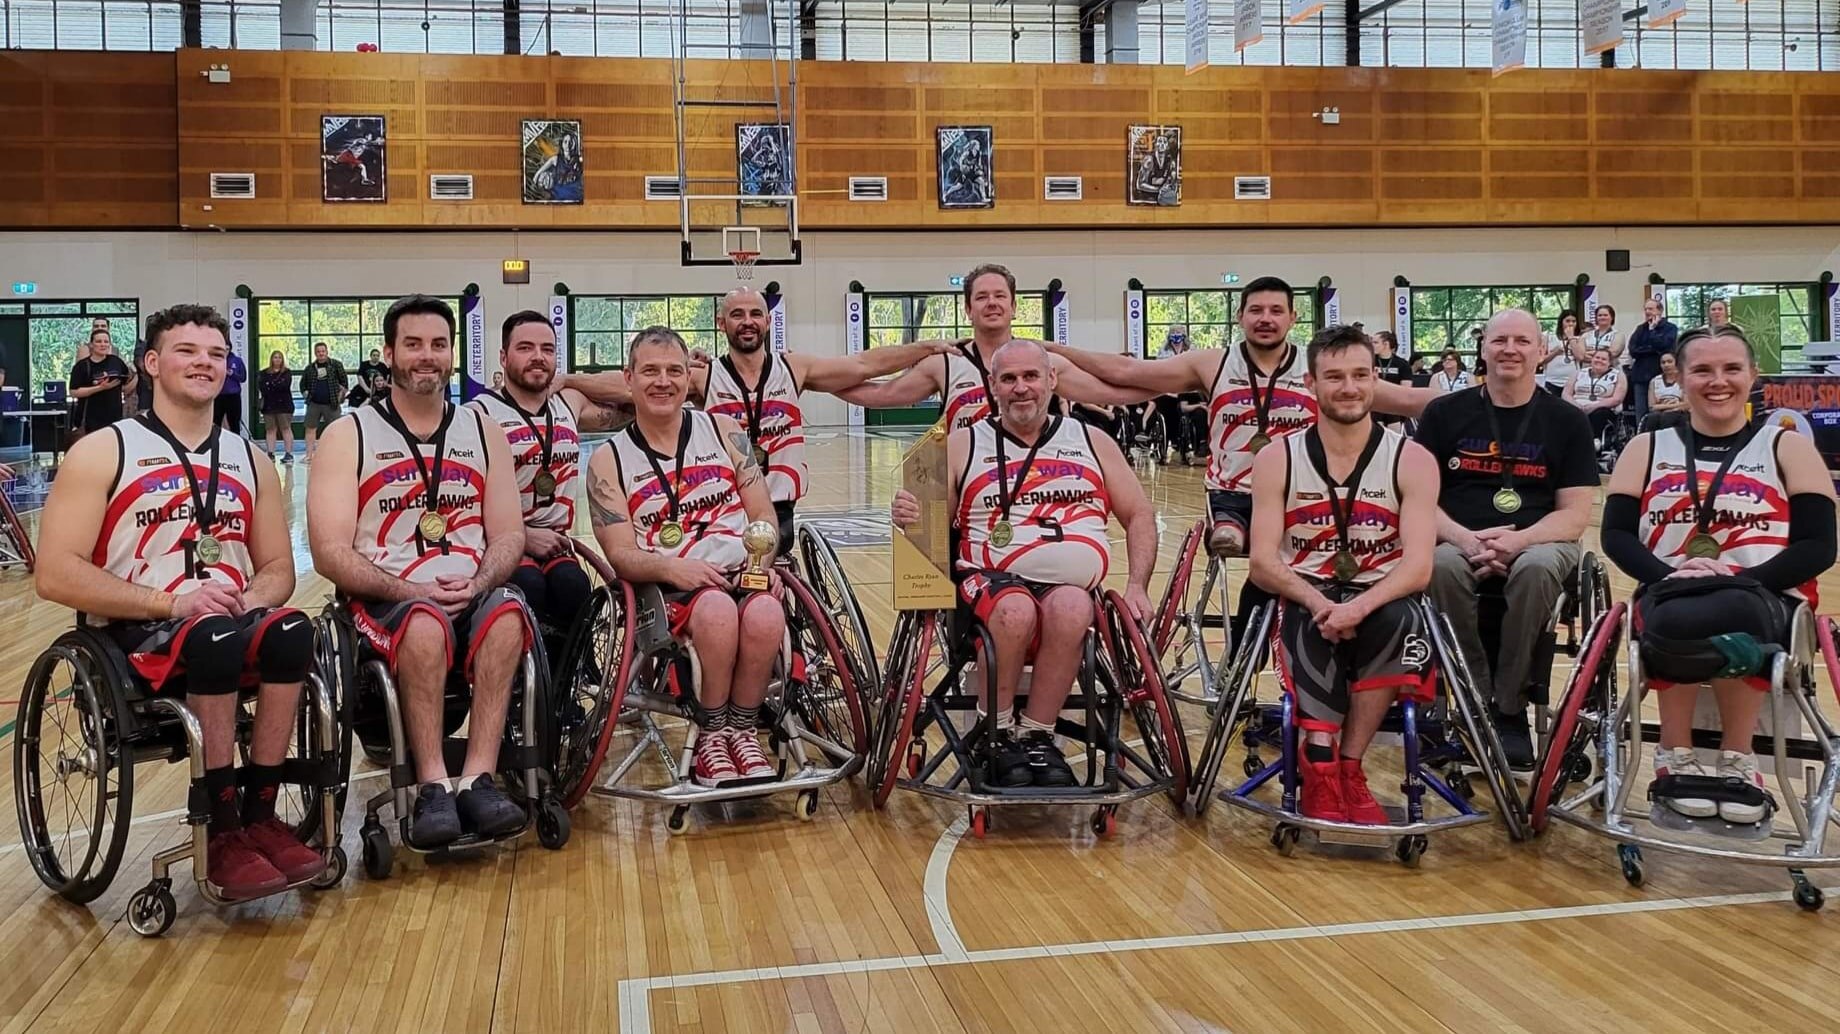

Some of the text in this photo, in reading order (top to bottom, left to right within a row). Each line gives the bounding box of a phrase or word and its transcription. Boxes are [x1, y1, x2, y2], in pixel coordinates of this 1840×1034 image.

[1763, 384, 1815, 409] PROUD
[688, 520, 710, 542] 7
[1037, 516, 1065, 542] 5
